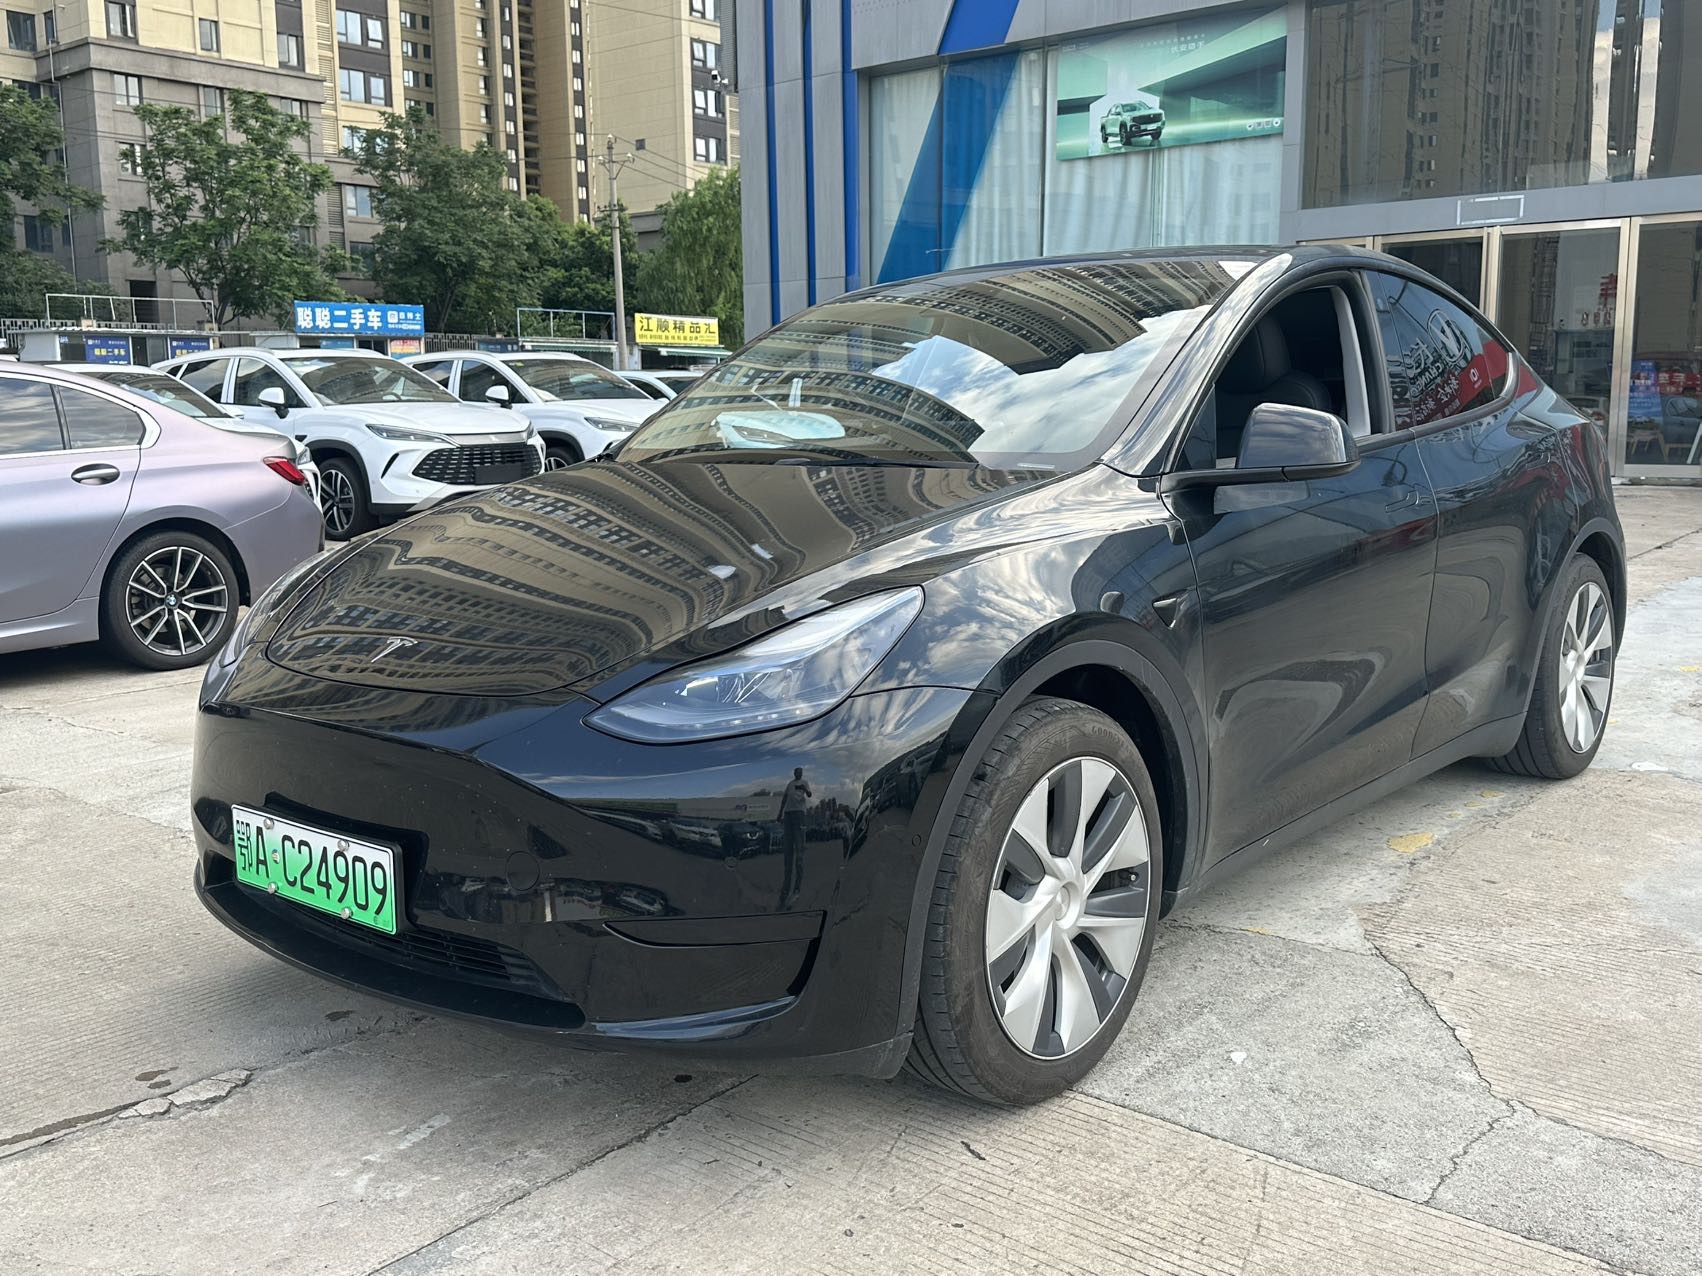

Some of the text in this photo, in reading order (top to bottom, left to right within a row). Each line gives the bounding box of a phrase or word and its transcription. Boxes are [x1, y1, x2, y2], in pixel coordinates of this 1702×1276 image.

[297, 307, 382, 330] 聪聪二手车
[639, 315, 716, 334] 江顺精品汇
[236, 819, 387, 916] 鄂A C24909
